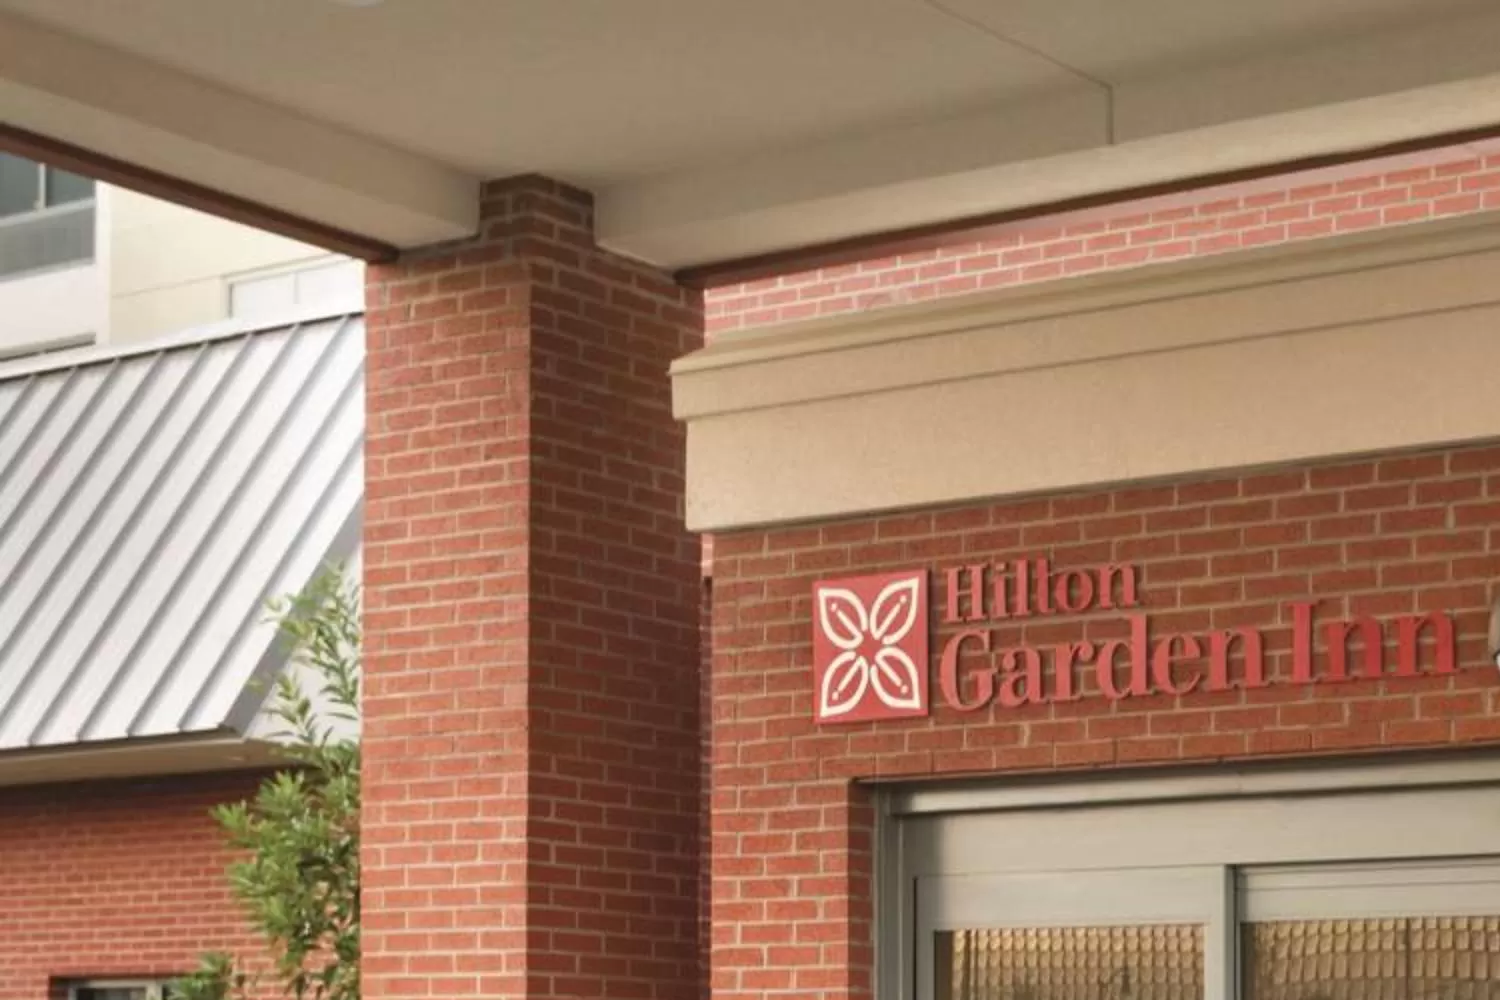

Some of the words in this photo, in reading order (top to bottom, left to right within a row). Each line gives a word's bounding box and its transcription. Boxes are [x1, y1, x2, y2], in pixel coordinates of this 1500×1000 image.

[941, 558, 1138, 624] Hilton
[939, 616, 1266, 713] Garden
[1291, 602, 1460, 684] Inn
